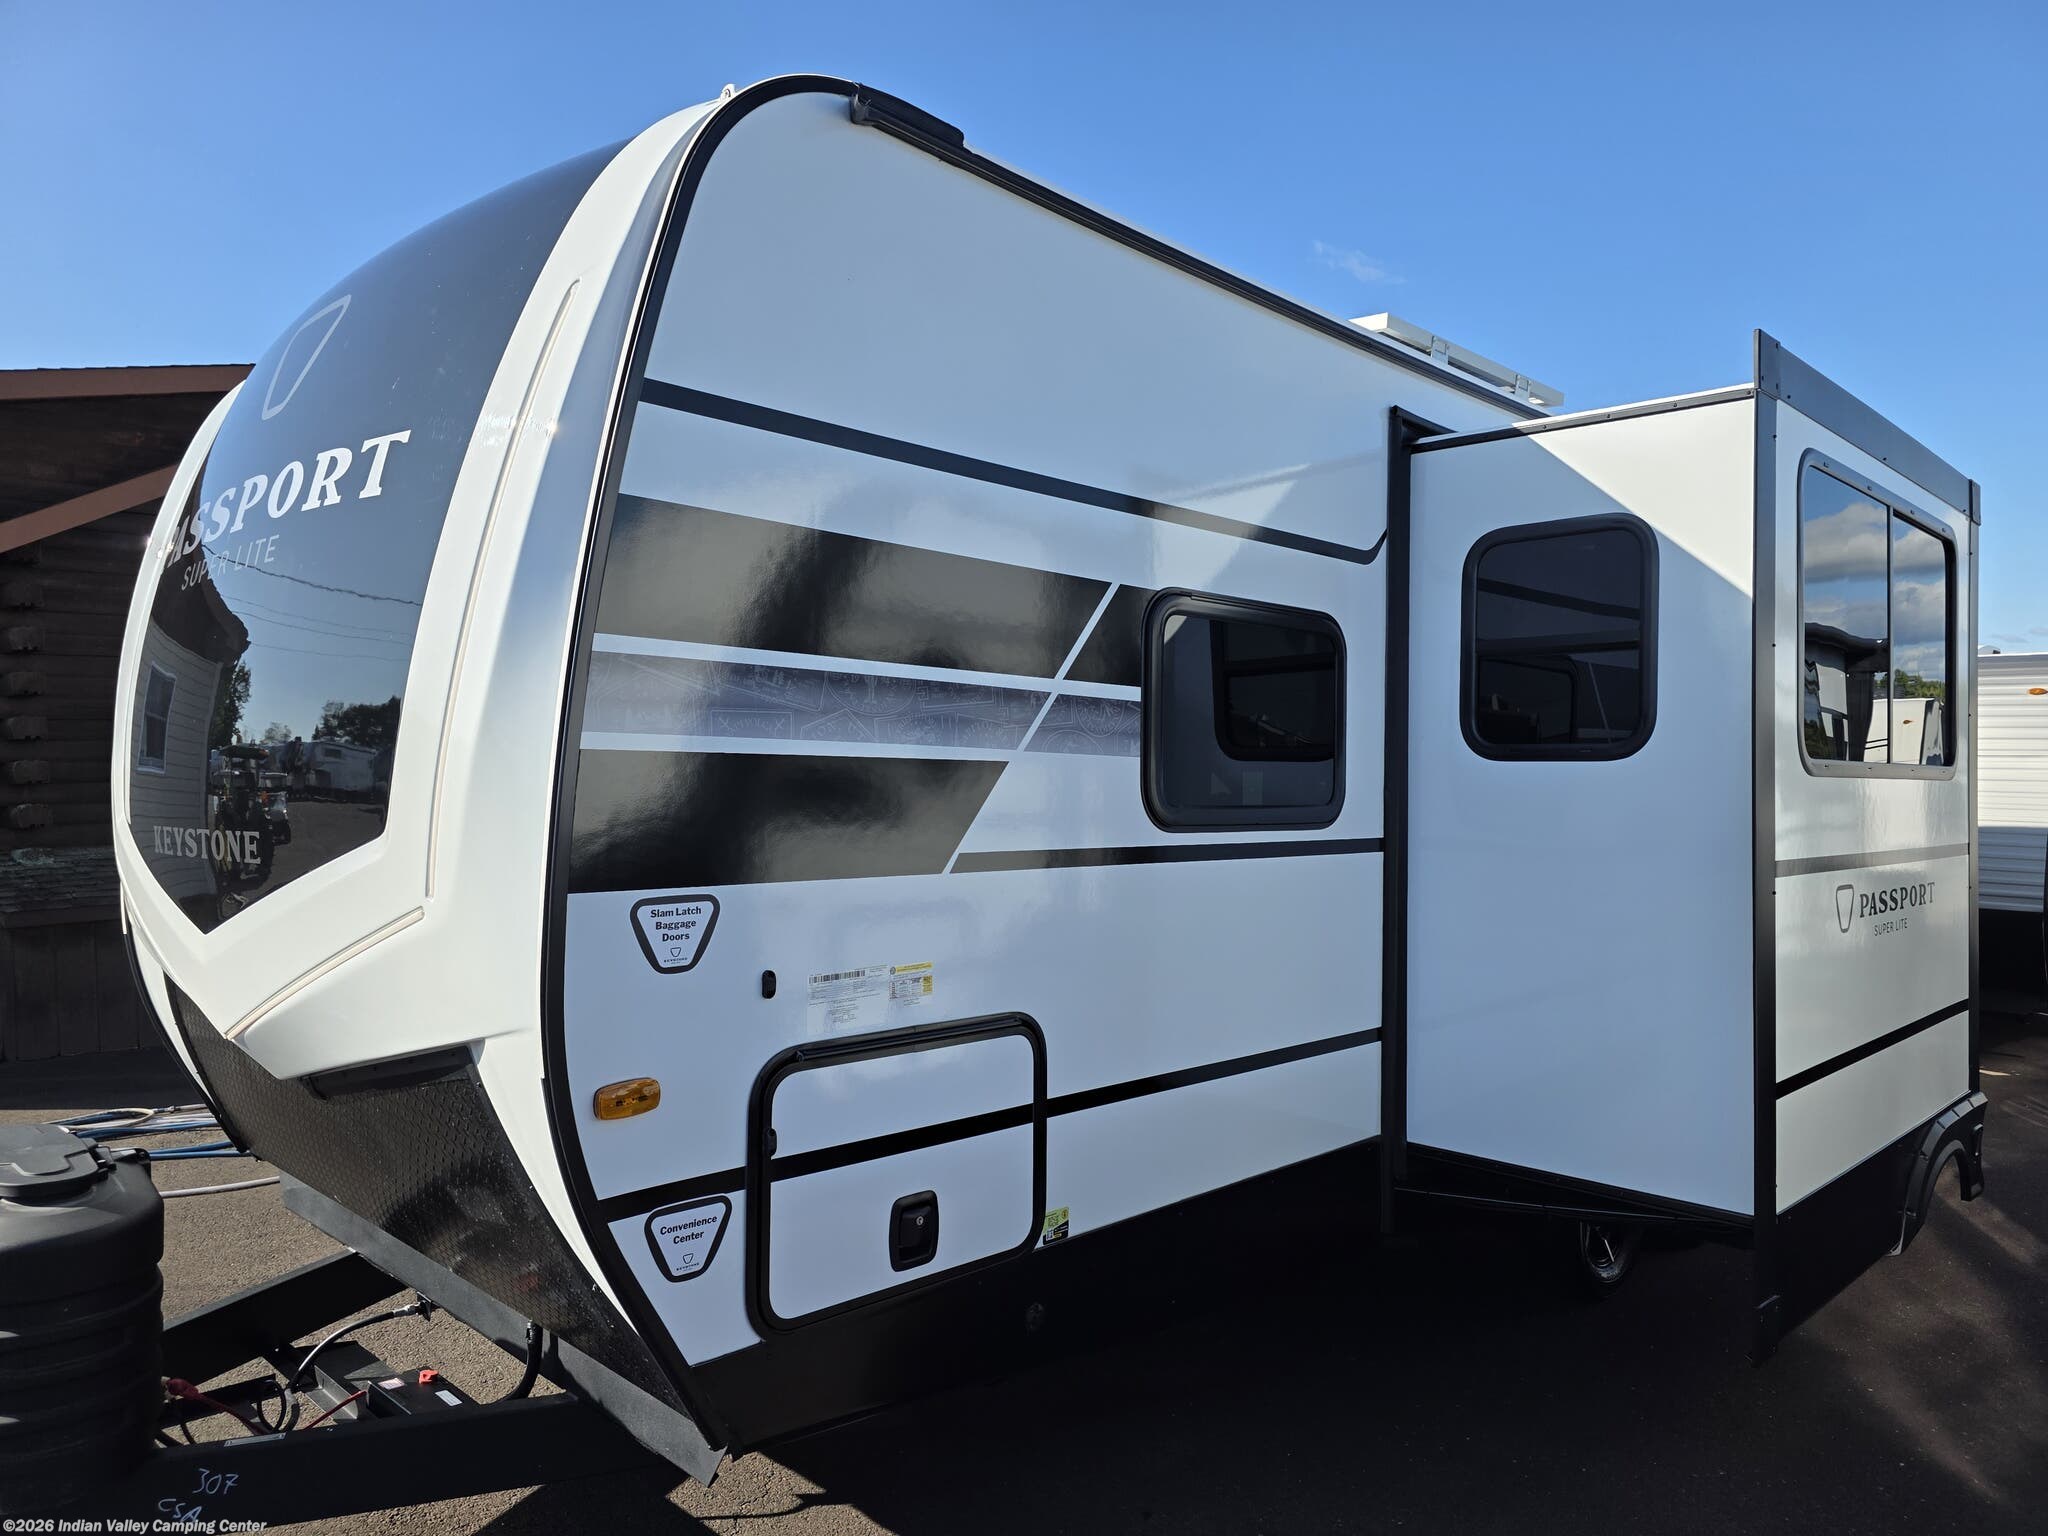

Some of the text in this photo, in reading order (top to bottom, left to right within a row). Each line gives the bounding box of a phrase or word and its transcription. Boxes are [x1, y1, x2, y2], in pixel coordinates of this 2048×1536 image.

[167, 430, 412, 568] ASSPORT
[181, 534, 280, 591] SUPER LITE
[153, 825, 261, 865] KEYSTONE
[1859, 882, 1935, 918] PASSPORT
[651, 906, 701, 918] Slam Latch
[655, 921, 696, 930] Baggage
[1874, 918, 1908, 936] SUPER LITE
[662, 933, 690, 942] Doors
[660, 1216, 718, 1235] Convenience
[673, 1231, 705, 1244] Center
[192, 1468, 239, 1495] 307
